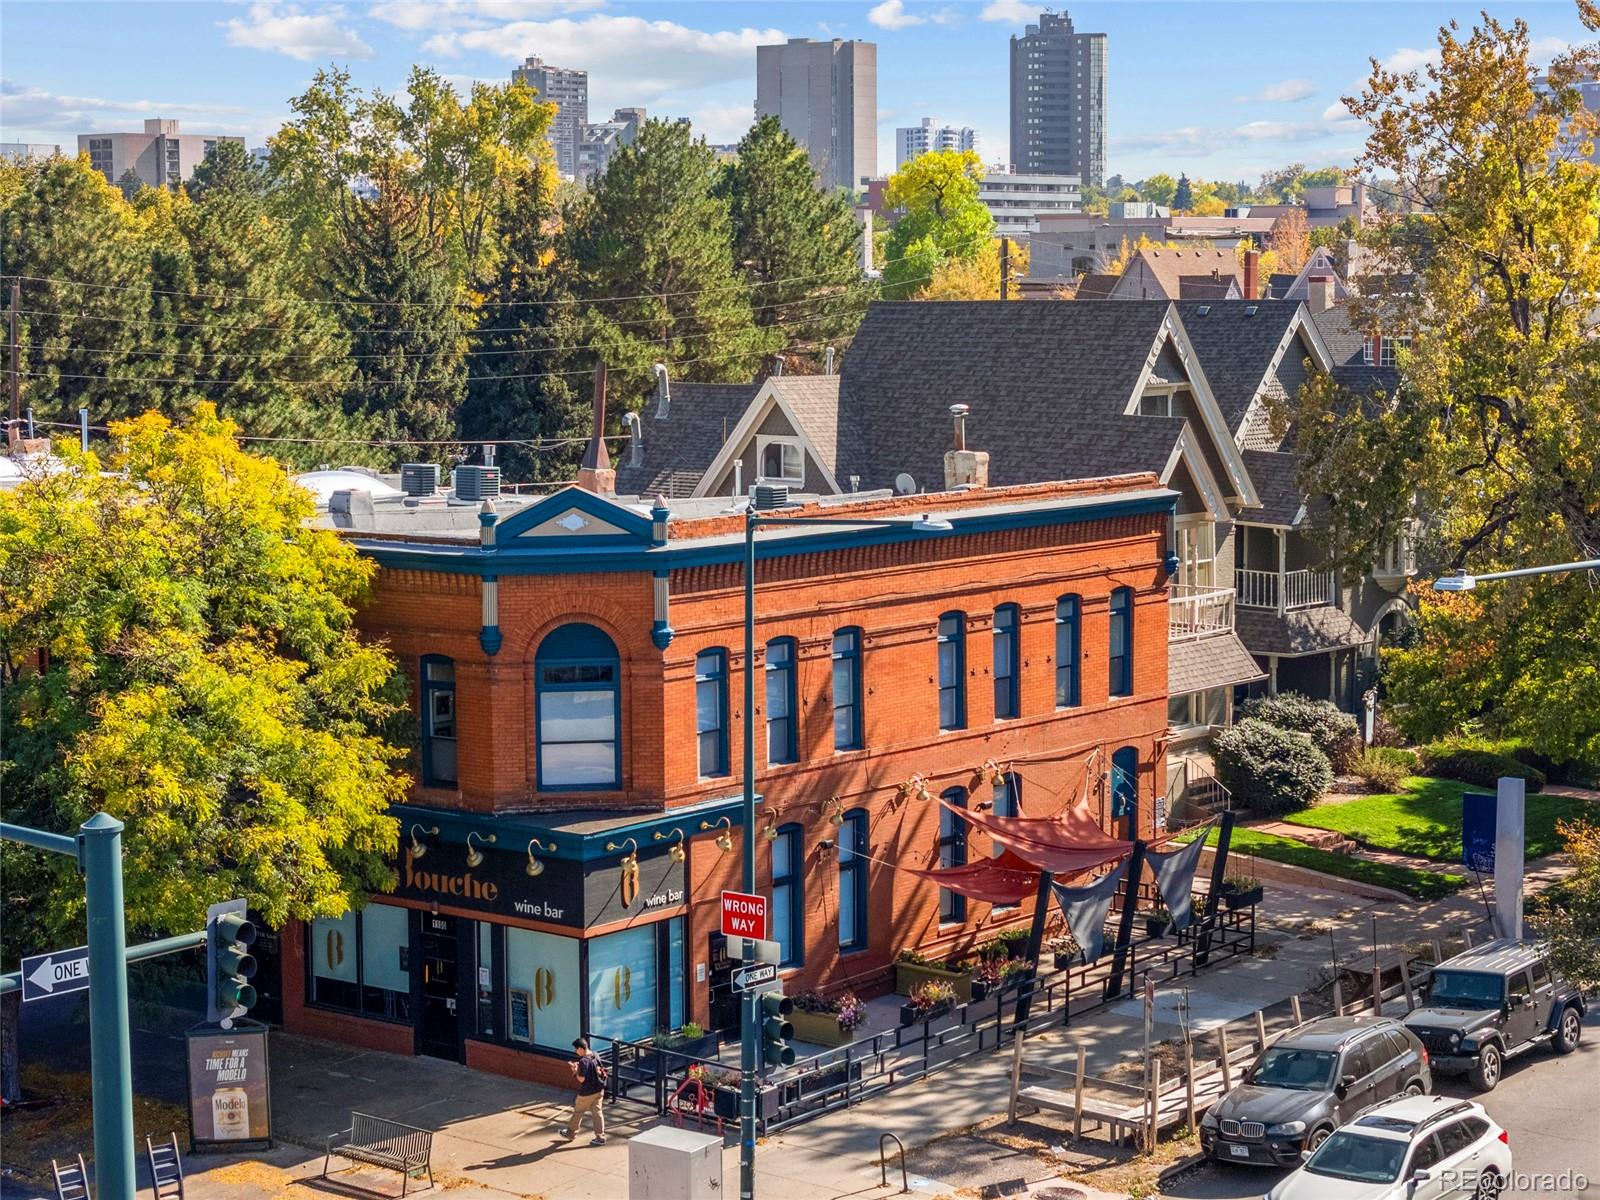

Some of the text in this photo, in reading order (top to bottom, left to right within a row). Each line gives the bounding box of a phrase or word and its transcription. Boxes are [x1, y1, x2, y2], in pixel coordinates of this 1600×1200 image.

[646, 889, 683, 907] wine bar
[514, 900, 564, 918] wine bar
[724, 898, 764, 916] WRONG
[731, 917, 755, 932] WAY
[54, 961, 81, 980] ONE
[745, 967, 773, 981] ONE WAY
[231, 1048, 248, 1057] MEANS
[205, 1057, 245, 1071] TIME FOR A
[216, 1068, 247, 1081] MODELO
[215, 1098, 245, 1111] Modelo
